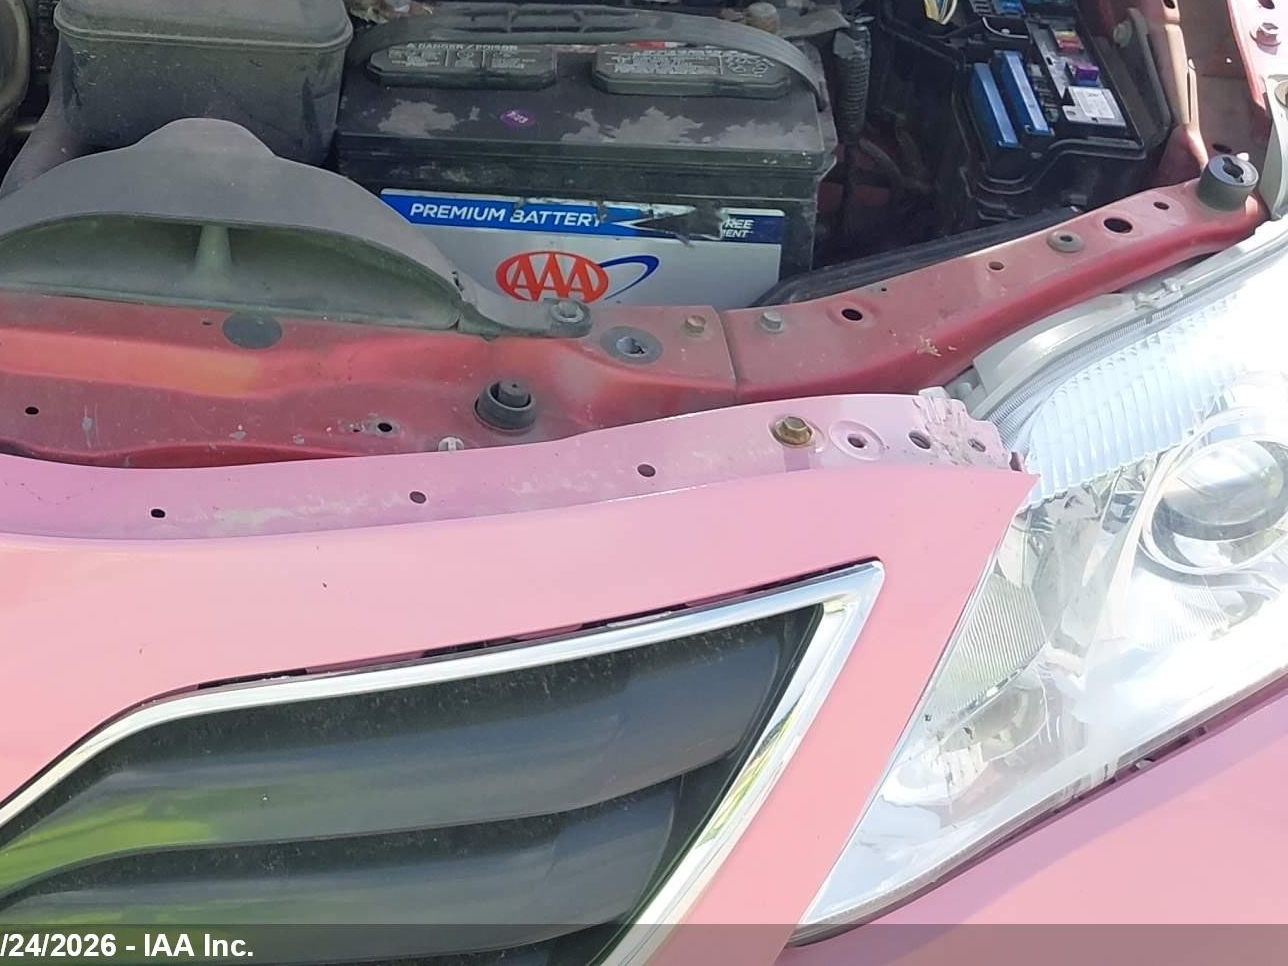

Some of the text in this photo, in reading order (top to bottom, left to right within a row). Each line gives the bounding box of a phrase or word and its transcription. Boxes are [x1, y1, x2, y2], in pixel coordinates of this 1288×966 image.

[409, 202, 608, 228] PREMIUM BATTERY
[723, 216, 756, 230] REE
[723, 229, 751, 238] ENT
[500, 249, 602, 303] AAA
